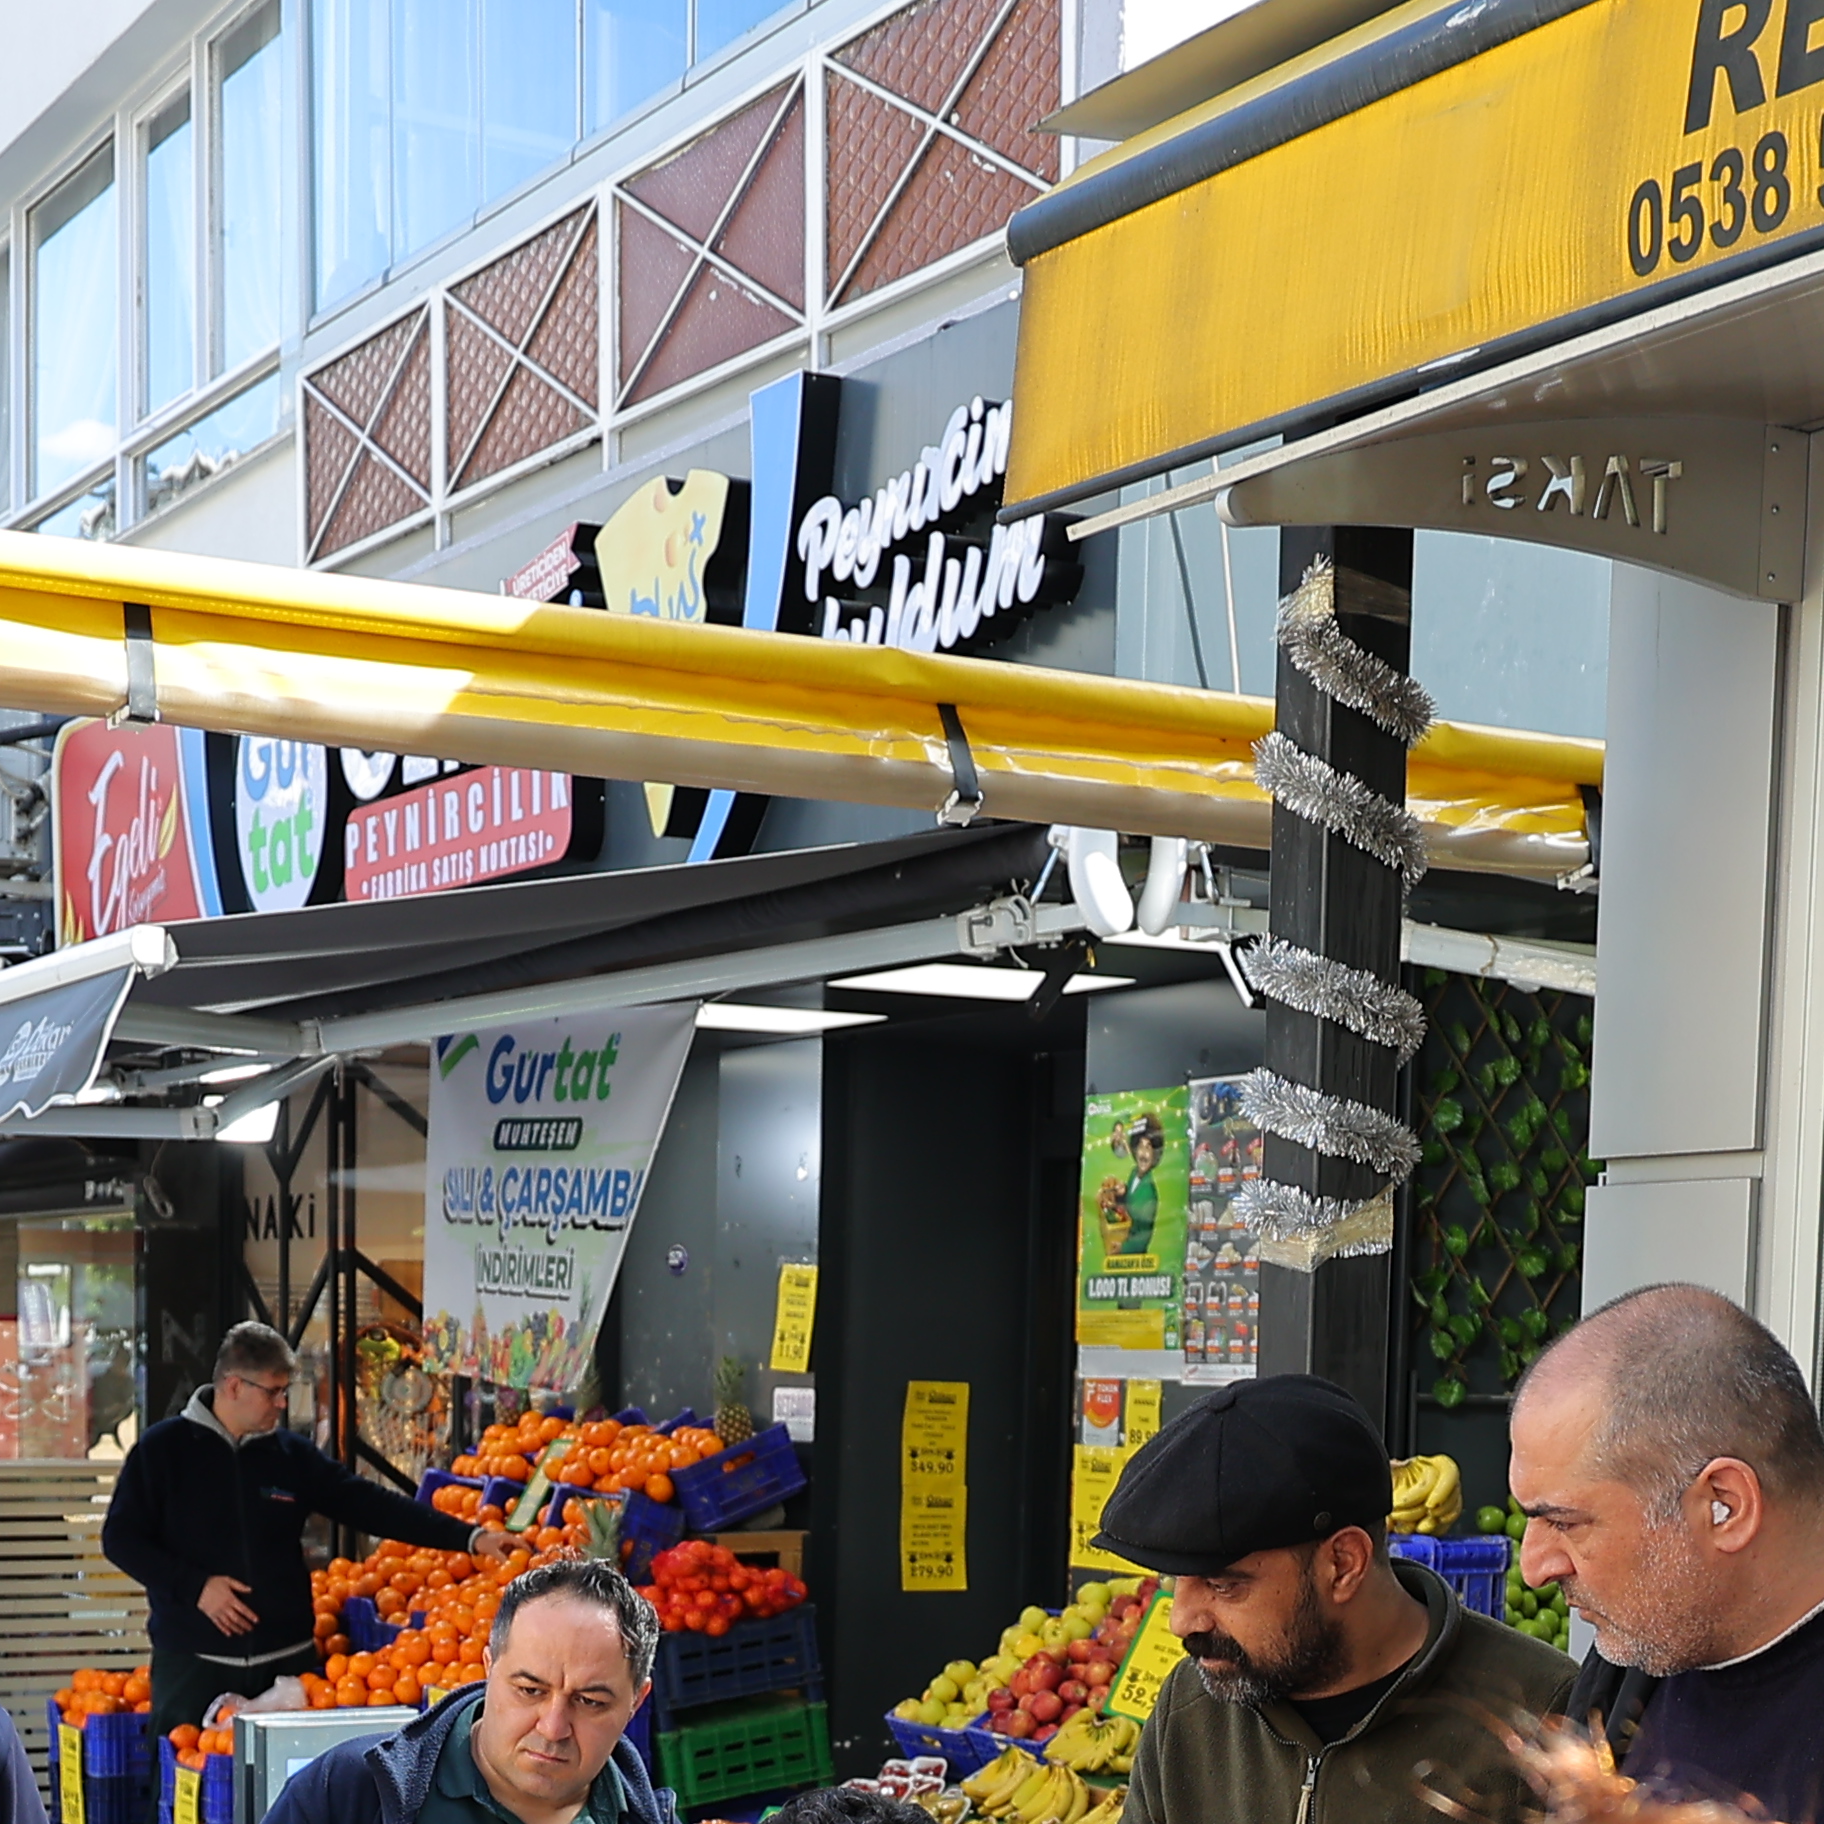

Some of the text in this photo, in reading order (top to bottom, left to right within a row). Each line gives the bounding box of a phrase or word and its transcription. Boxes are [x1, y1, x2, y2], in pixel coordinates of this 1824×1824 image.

[1628, 131, 1790, 277] 0538
[249, 789, 314, 893] tat
[370, 829, 544, 900] FABRİKA SATIŞ NOKTASI
[485, 1033, 617, 1104] Gürtat
[498, 1121, 578, 1149] MUHTEŞEM
[480, 1167, 494, 1212] &
[476, 1243, 574, 1291] İNDİRİMLERİ
